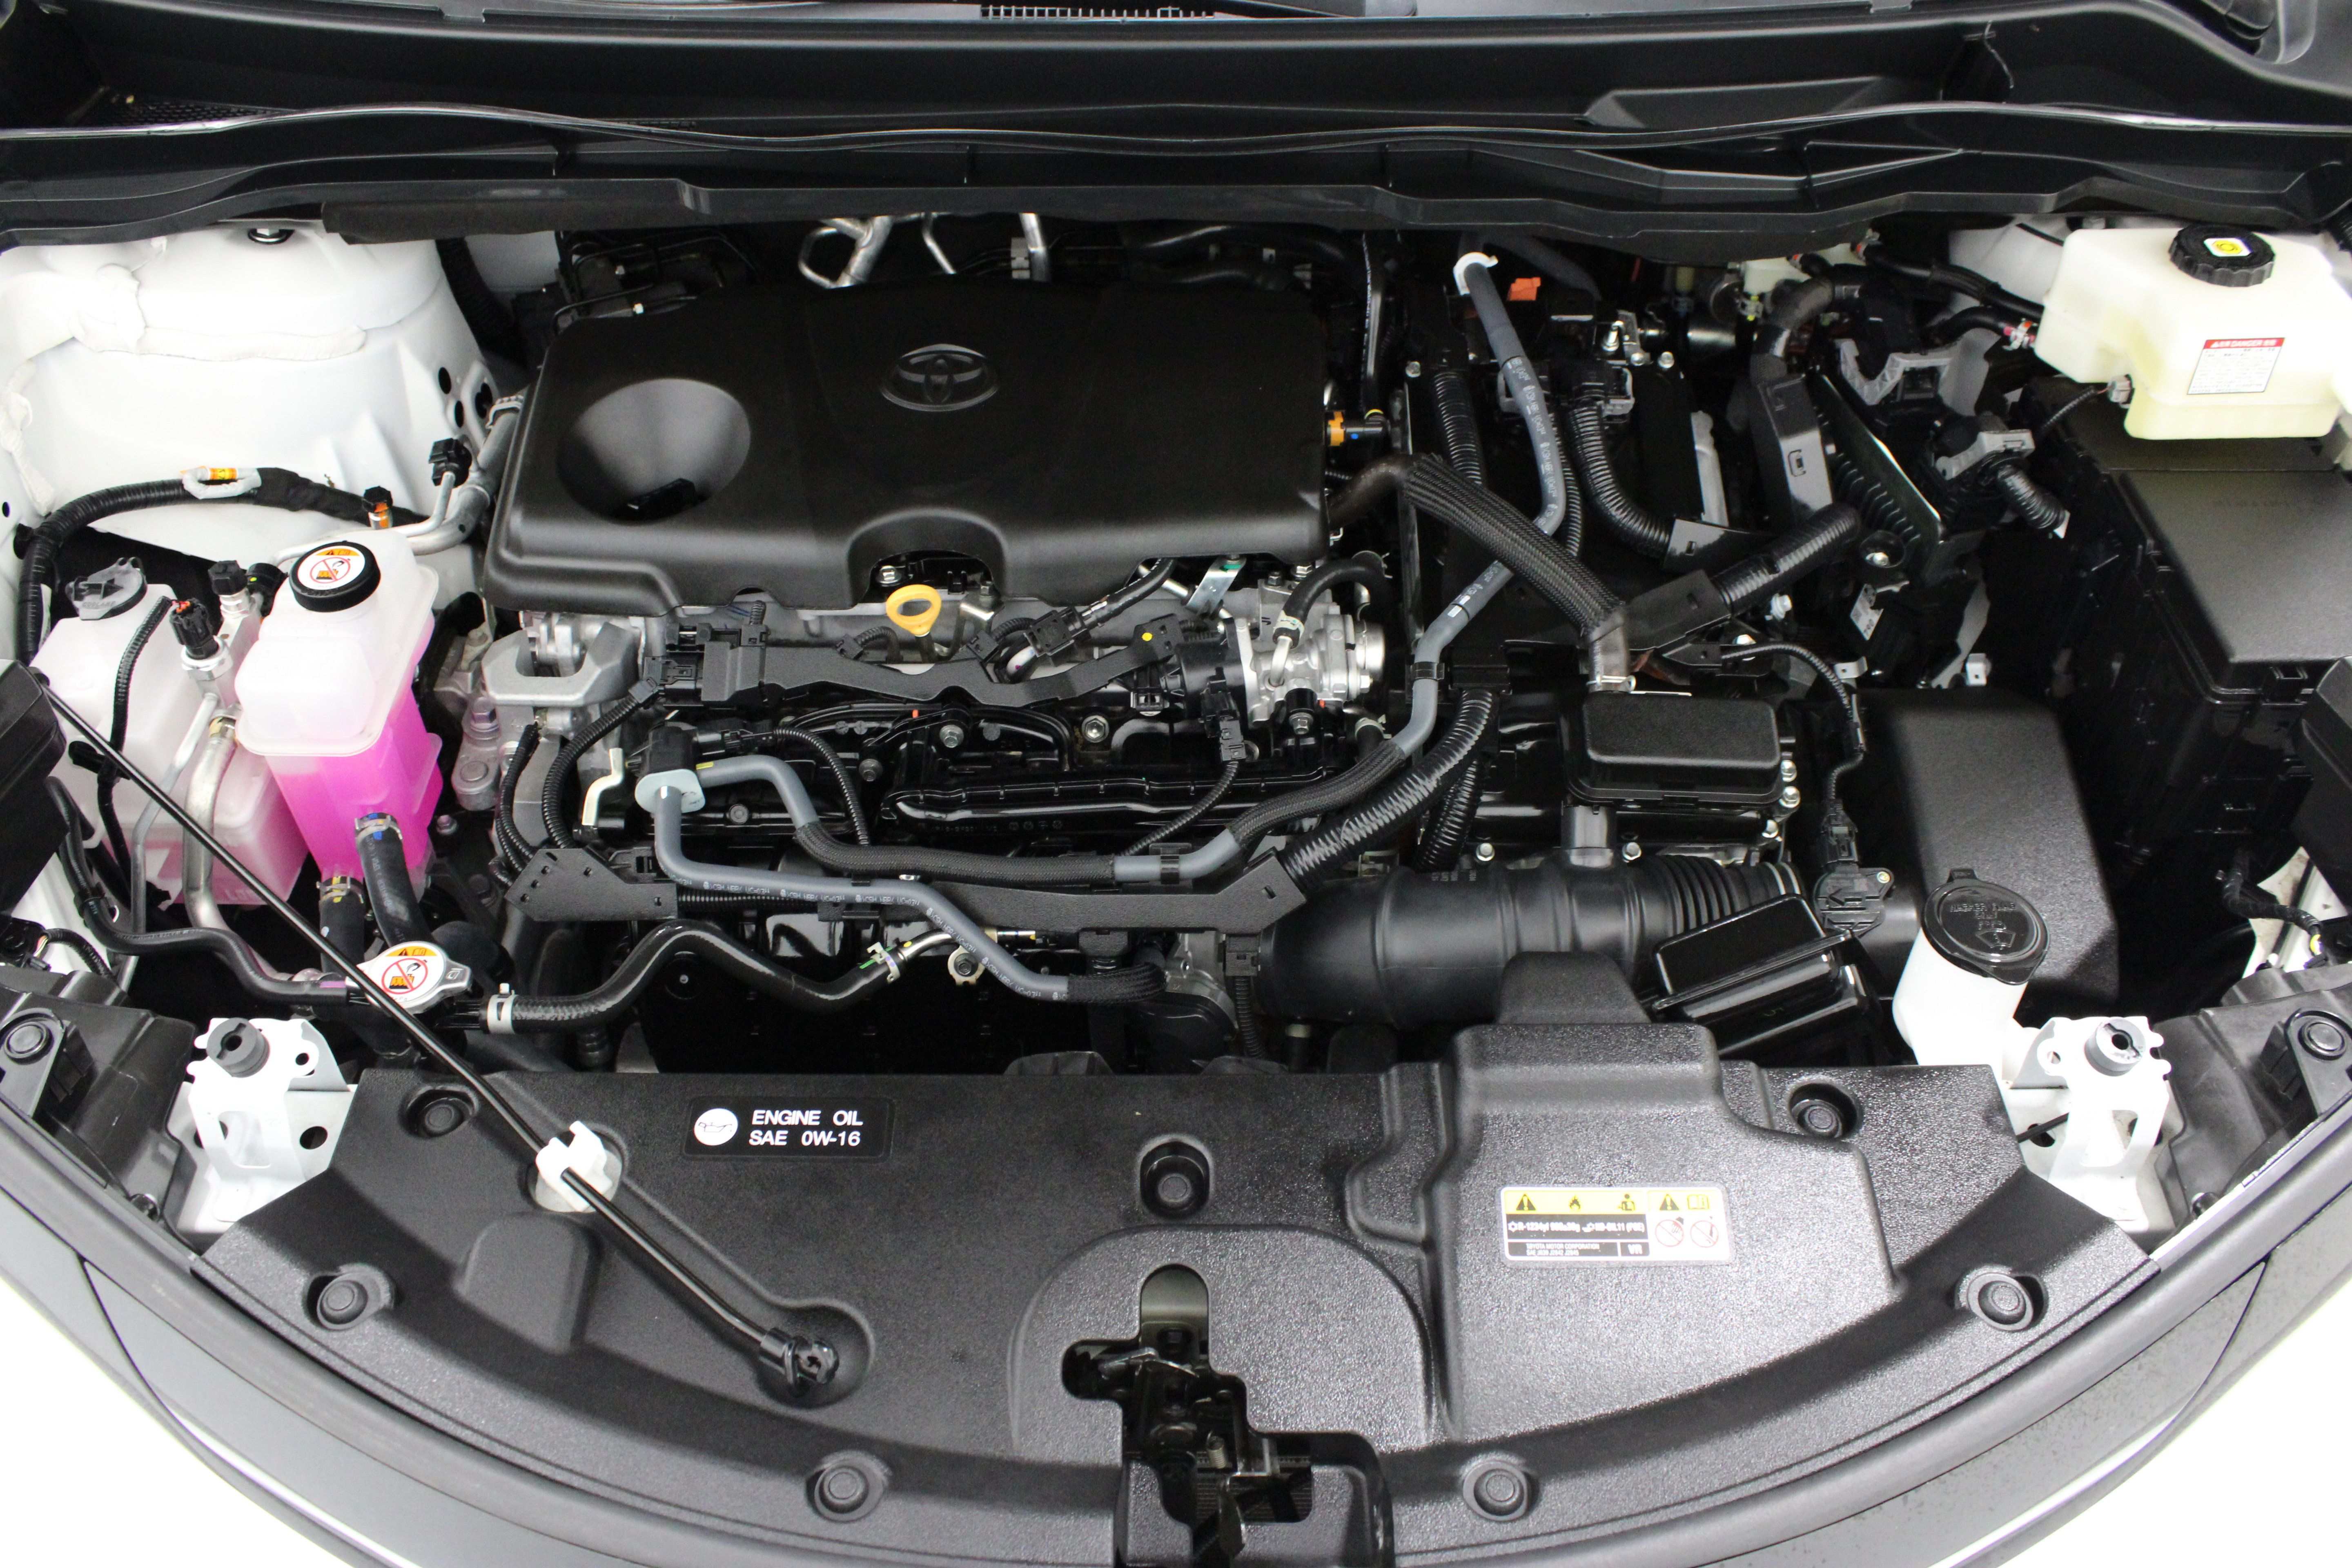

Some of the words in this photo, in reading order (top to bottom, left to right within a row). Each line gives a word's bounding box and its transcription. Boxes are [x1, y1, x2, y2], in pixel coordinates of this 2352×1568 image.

[751, 1109, 822, 1125] ENGINE
[832, 1110, 863, 1126] OIL
[748, 1129, 788, 1146] SAE
[801, 1130, 861, 1146] 0W-16
[1628, 1244, 1642, 1255] VR
